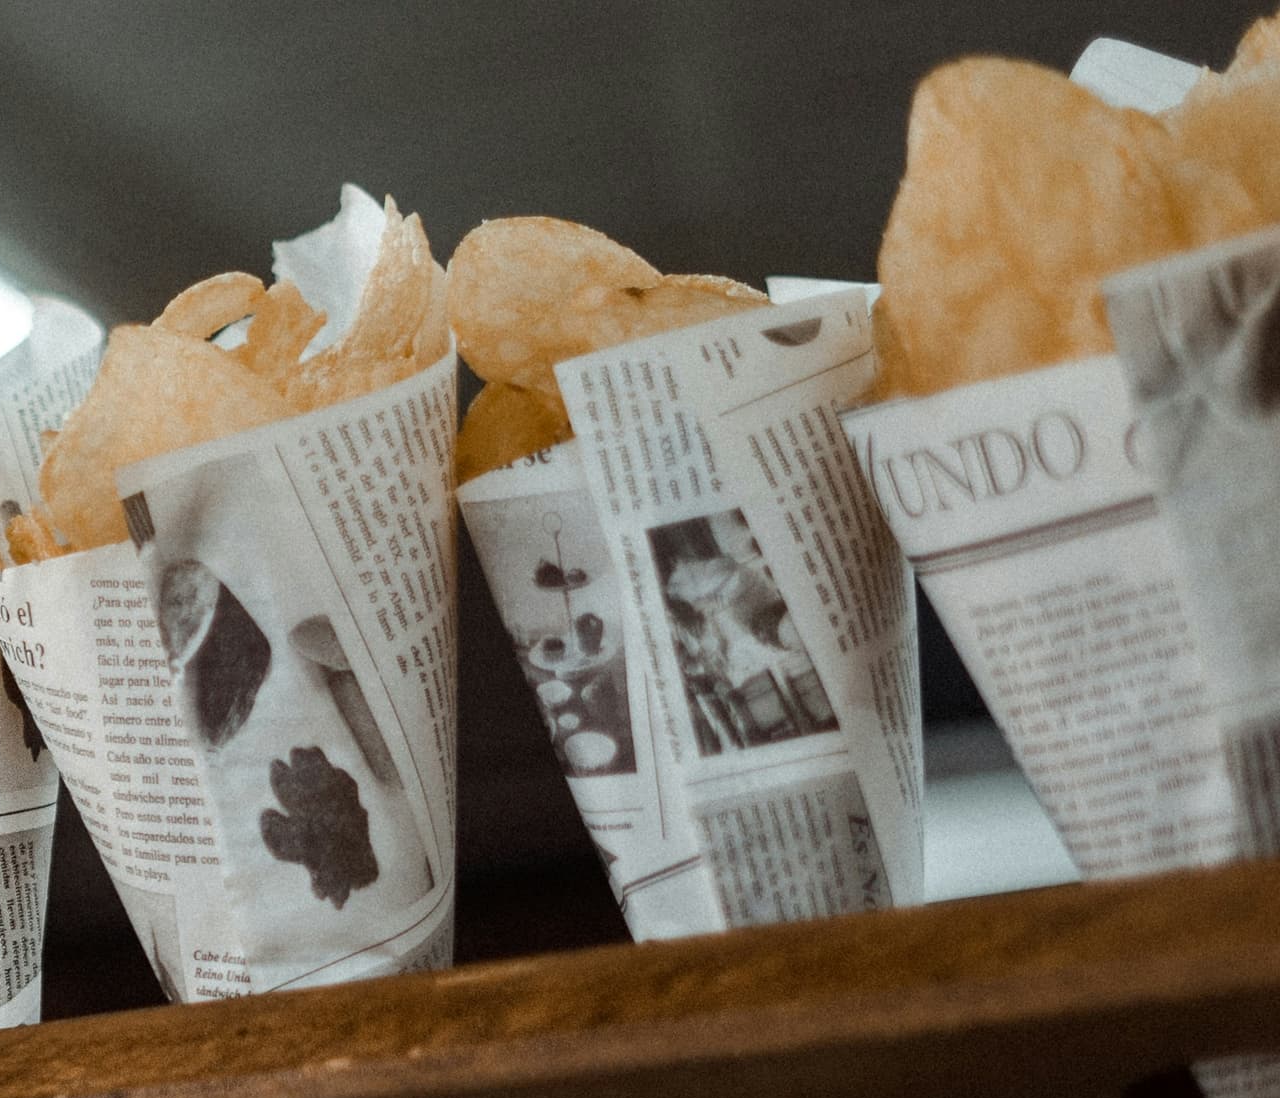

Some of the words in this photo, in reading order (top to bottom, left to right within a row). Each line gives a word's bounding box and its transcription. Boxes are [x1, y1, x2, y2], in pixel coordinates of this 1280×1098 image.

[868, 410, 1085, 520] UNDO
[359, 472, 376, 492] del
[369, 498, 390, 529] siglo
[399, 571, 419, 605] como
[89, 578, 120, 589] como
[14, 599, 37, 628] el
[94, 633, 120, 648] más,
[96, 653, 120, 667] fácil
[98, 674, 125, 689] jugar
[127, 676, 150, 689] para
[125, 693, 155, 707] nació
[102, 712, 142, 727] primero
[144, 715, 171, 727] entre
[106, 750, 131, 764] Cada
[132, 751, 152, 765] año
[141, 772, 160, 785] mil
[136, 811, 163, 824] estos
[165, 811, 199, 825] suelen
[131, 829, 195, 846] emparedados
[134, 846, 171, 862] familias
[174, 852, 197, 866] para
[199, 854, 221, 866] con
[142, 867, 172, 883] playa.
[194, 966, 224, 981] Reino
